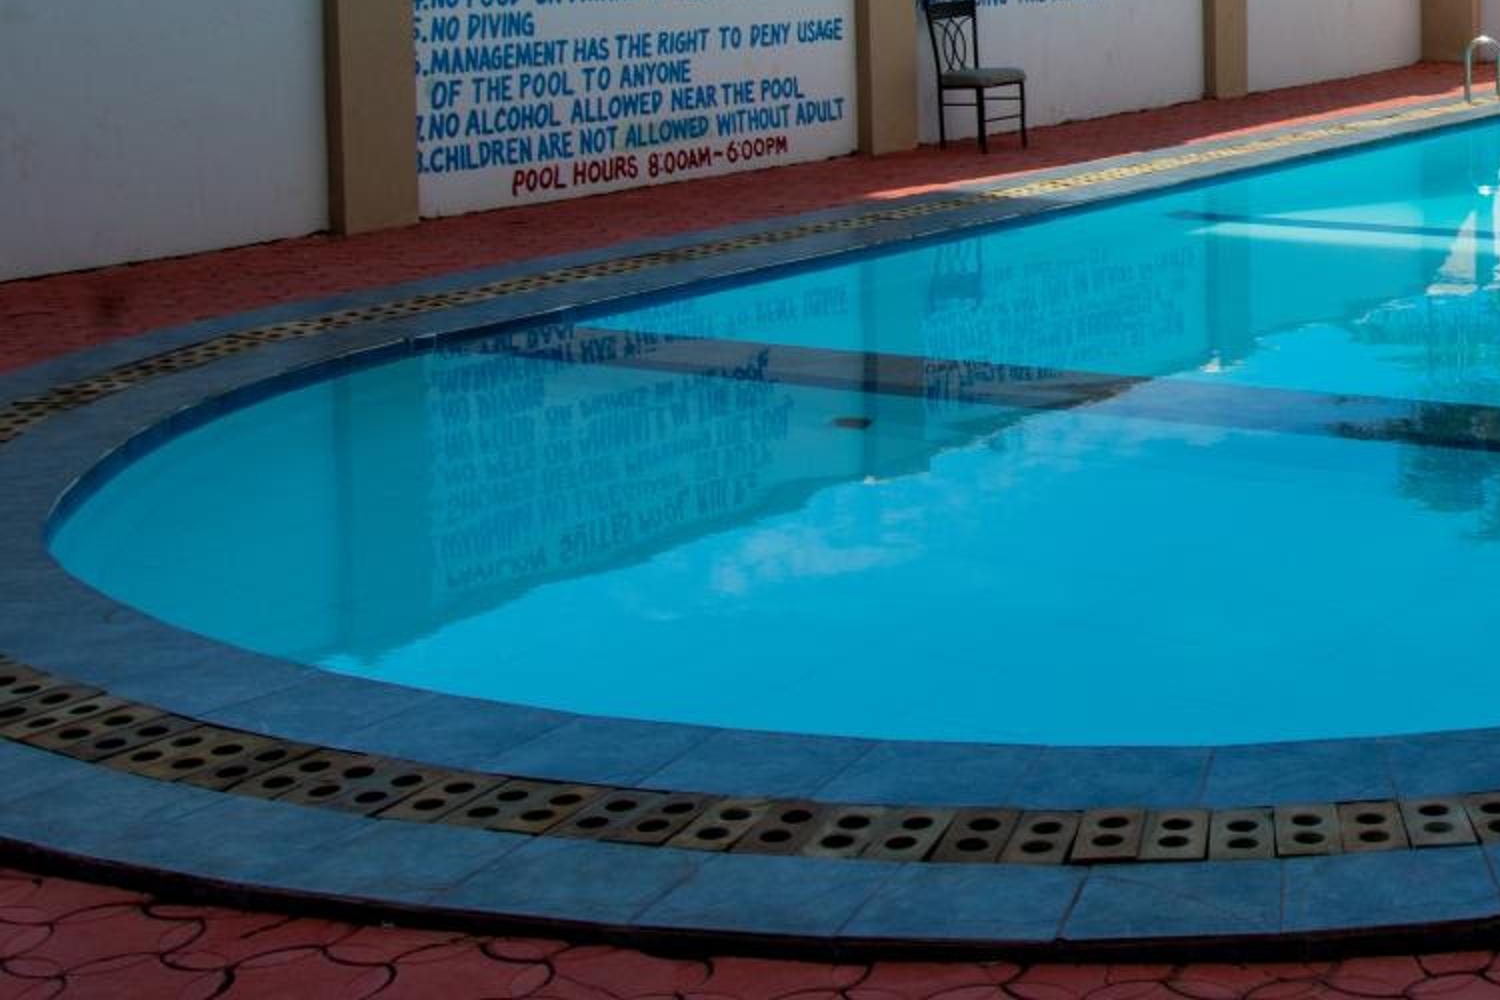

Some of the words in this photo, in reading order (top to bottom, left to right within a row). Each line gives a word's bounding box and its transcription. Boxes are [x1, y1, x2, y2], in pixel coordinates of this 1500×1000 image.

[467, 11, 535, 40] DIVING
[573, 37, 609, 63] HAS
[615, 32, 651, 60] THE
[657, 28, 710, 55] RIGHT
[719, 26, 742, 50] TO
[750, 21, 791, 48] DENY
[797, 17, 843, 43] USAGE
[431, 80, 462, 110] OF
[472, 74, 513, 104] THE
[519, 71, 574, 100] POOL
[582, 66, 611, 92] TO
[620, 59, 691, 90] ANYONE
[465, 103, 561, 137] ALCOHOL
[570, 90, 663, 125] ALLOWED
[671, 83, 718, 113] NEAR
[721, 79, 754, 106] THE
[761, 75, 804, 100] POOL
[537, 130, 574, 161] ARE
[579, 126, 618, 154] NOT
[625, 115, 709, 149] ALLOWED
[716, 103, 791, 137] WITHOUT
[795, 97, 845, 126] ADULT
[512, 164, 567, 197] POOL
[573, 155, 639, 185] HOURS
